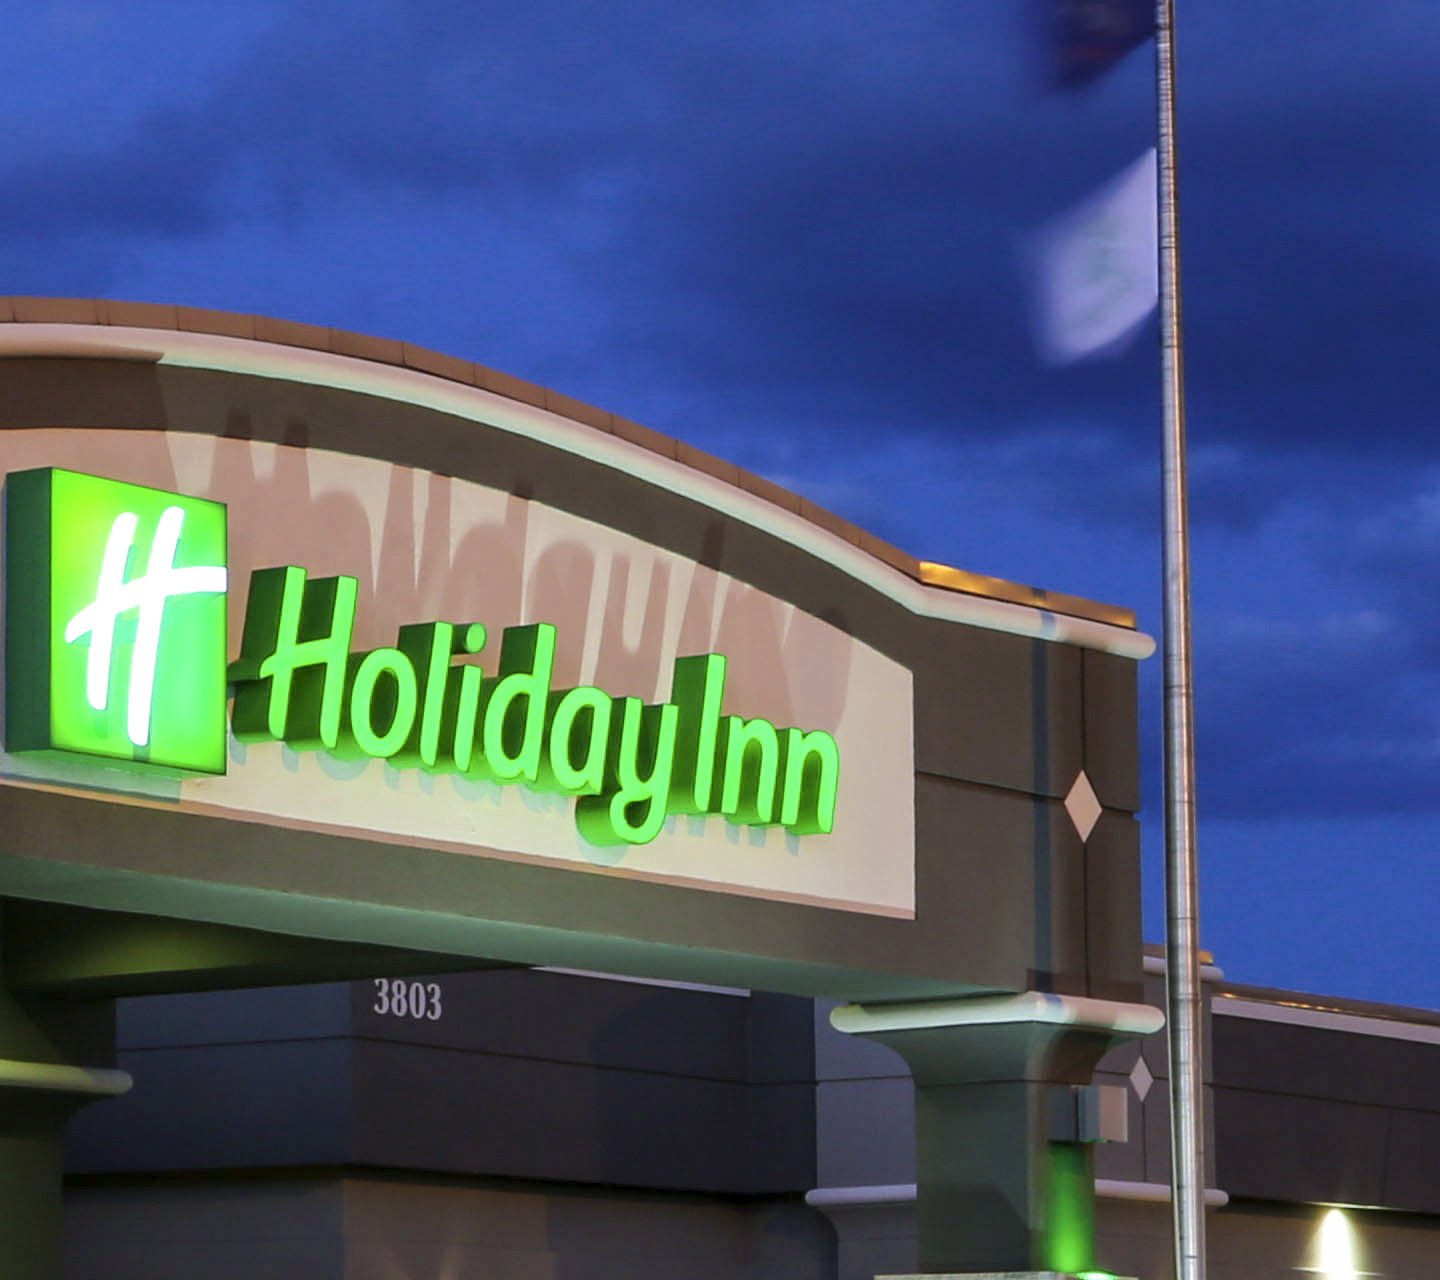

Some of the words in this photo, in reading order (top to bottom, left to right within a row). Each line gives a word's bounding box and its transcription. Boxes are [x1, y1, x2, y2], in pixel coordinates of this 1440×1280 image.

[64, 505, 227, 747] H
[258, 566, 678, 846] Holiday
[693, 653, 840, 835] Inn
[373, 977, 442, 1020] 3803
